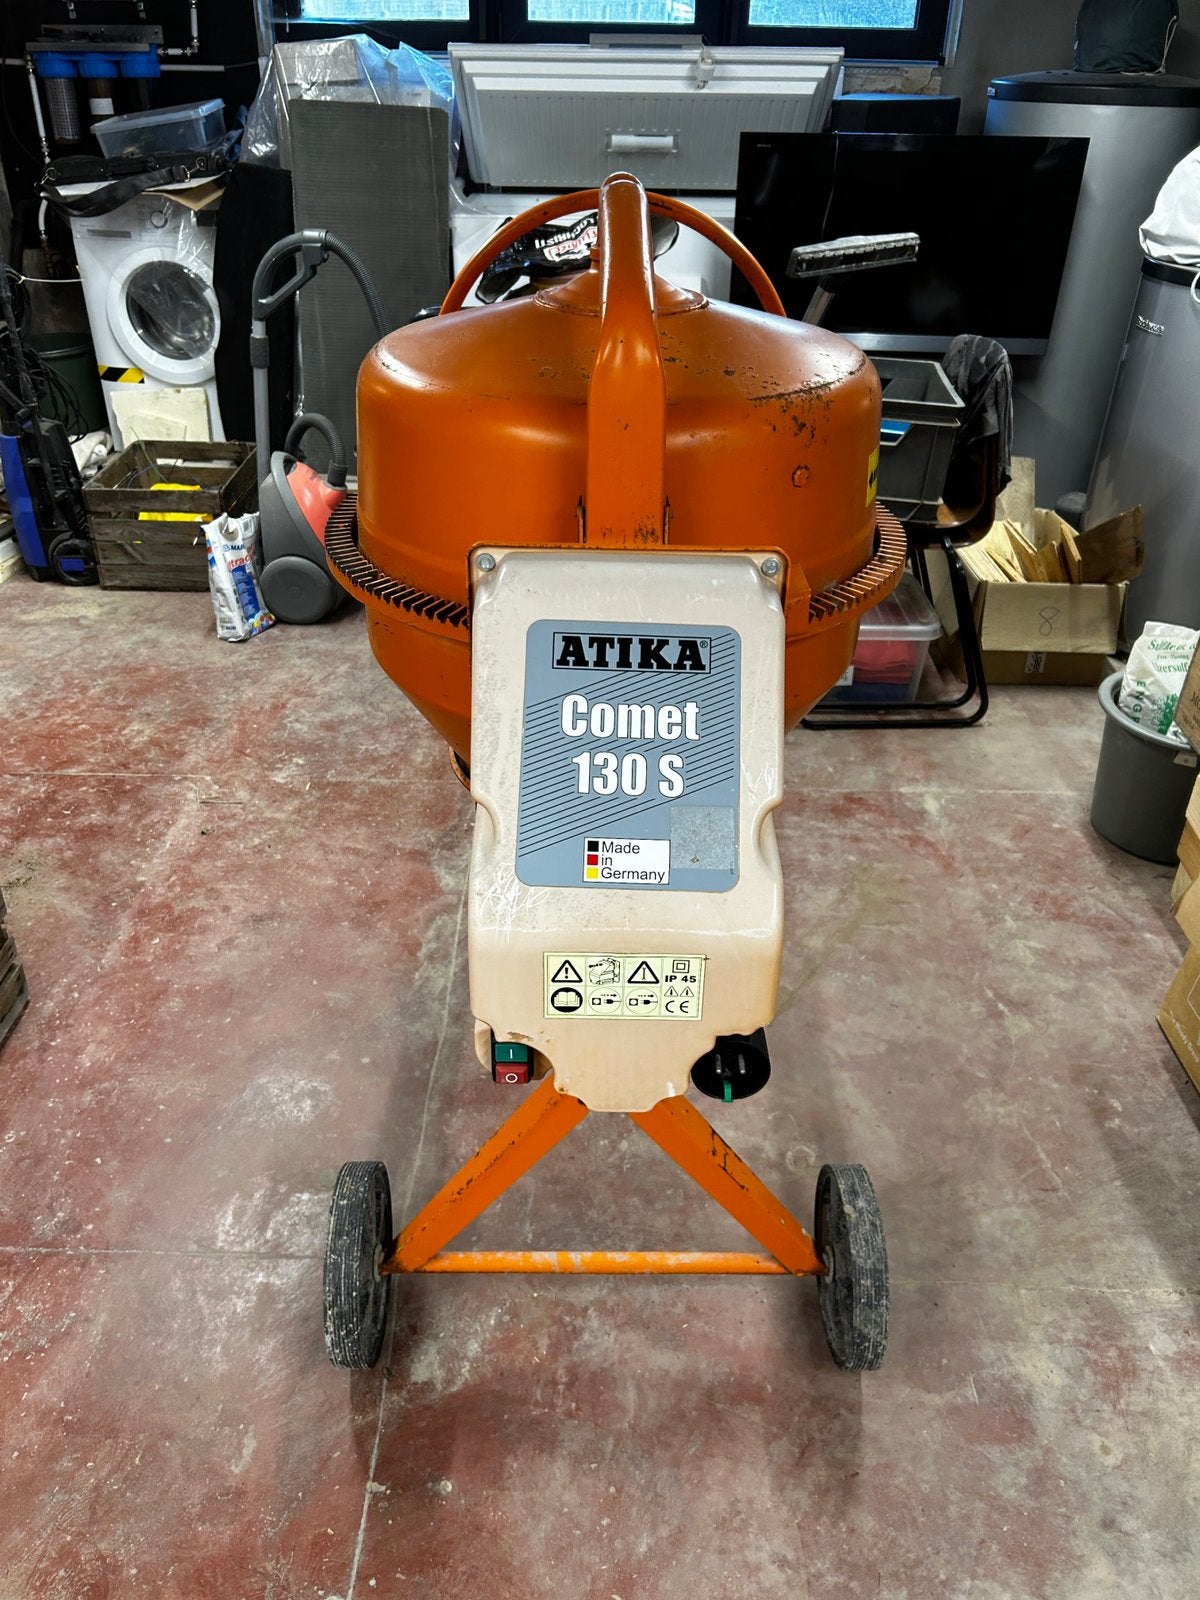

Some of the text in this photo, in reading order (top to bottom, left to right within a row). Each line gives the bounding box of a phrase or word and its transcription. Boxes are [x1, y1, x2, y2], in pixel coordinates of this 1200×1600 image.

[1039, 606, 1060, 636] 8
[556, 636, 706, 670] ATIKA
[560, 693, 700, 741] Comet
[572, 751, 685, 798] 130 S
[601, 841, 641, 854] Made
[601, 854, 613, 866] in
[601, 866, 666, 884] Germany
[664, 974, 697, 983] IP 45
